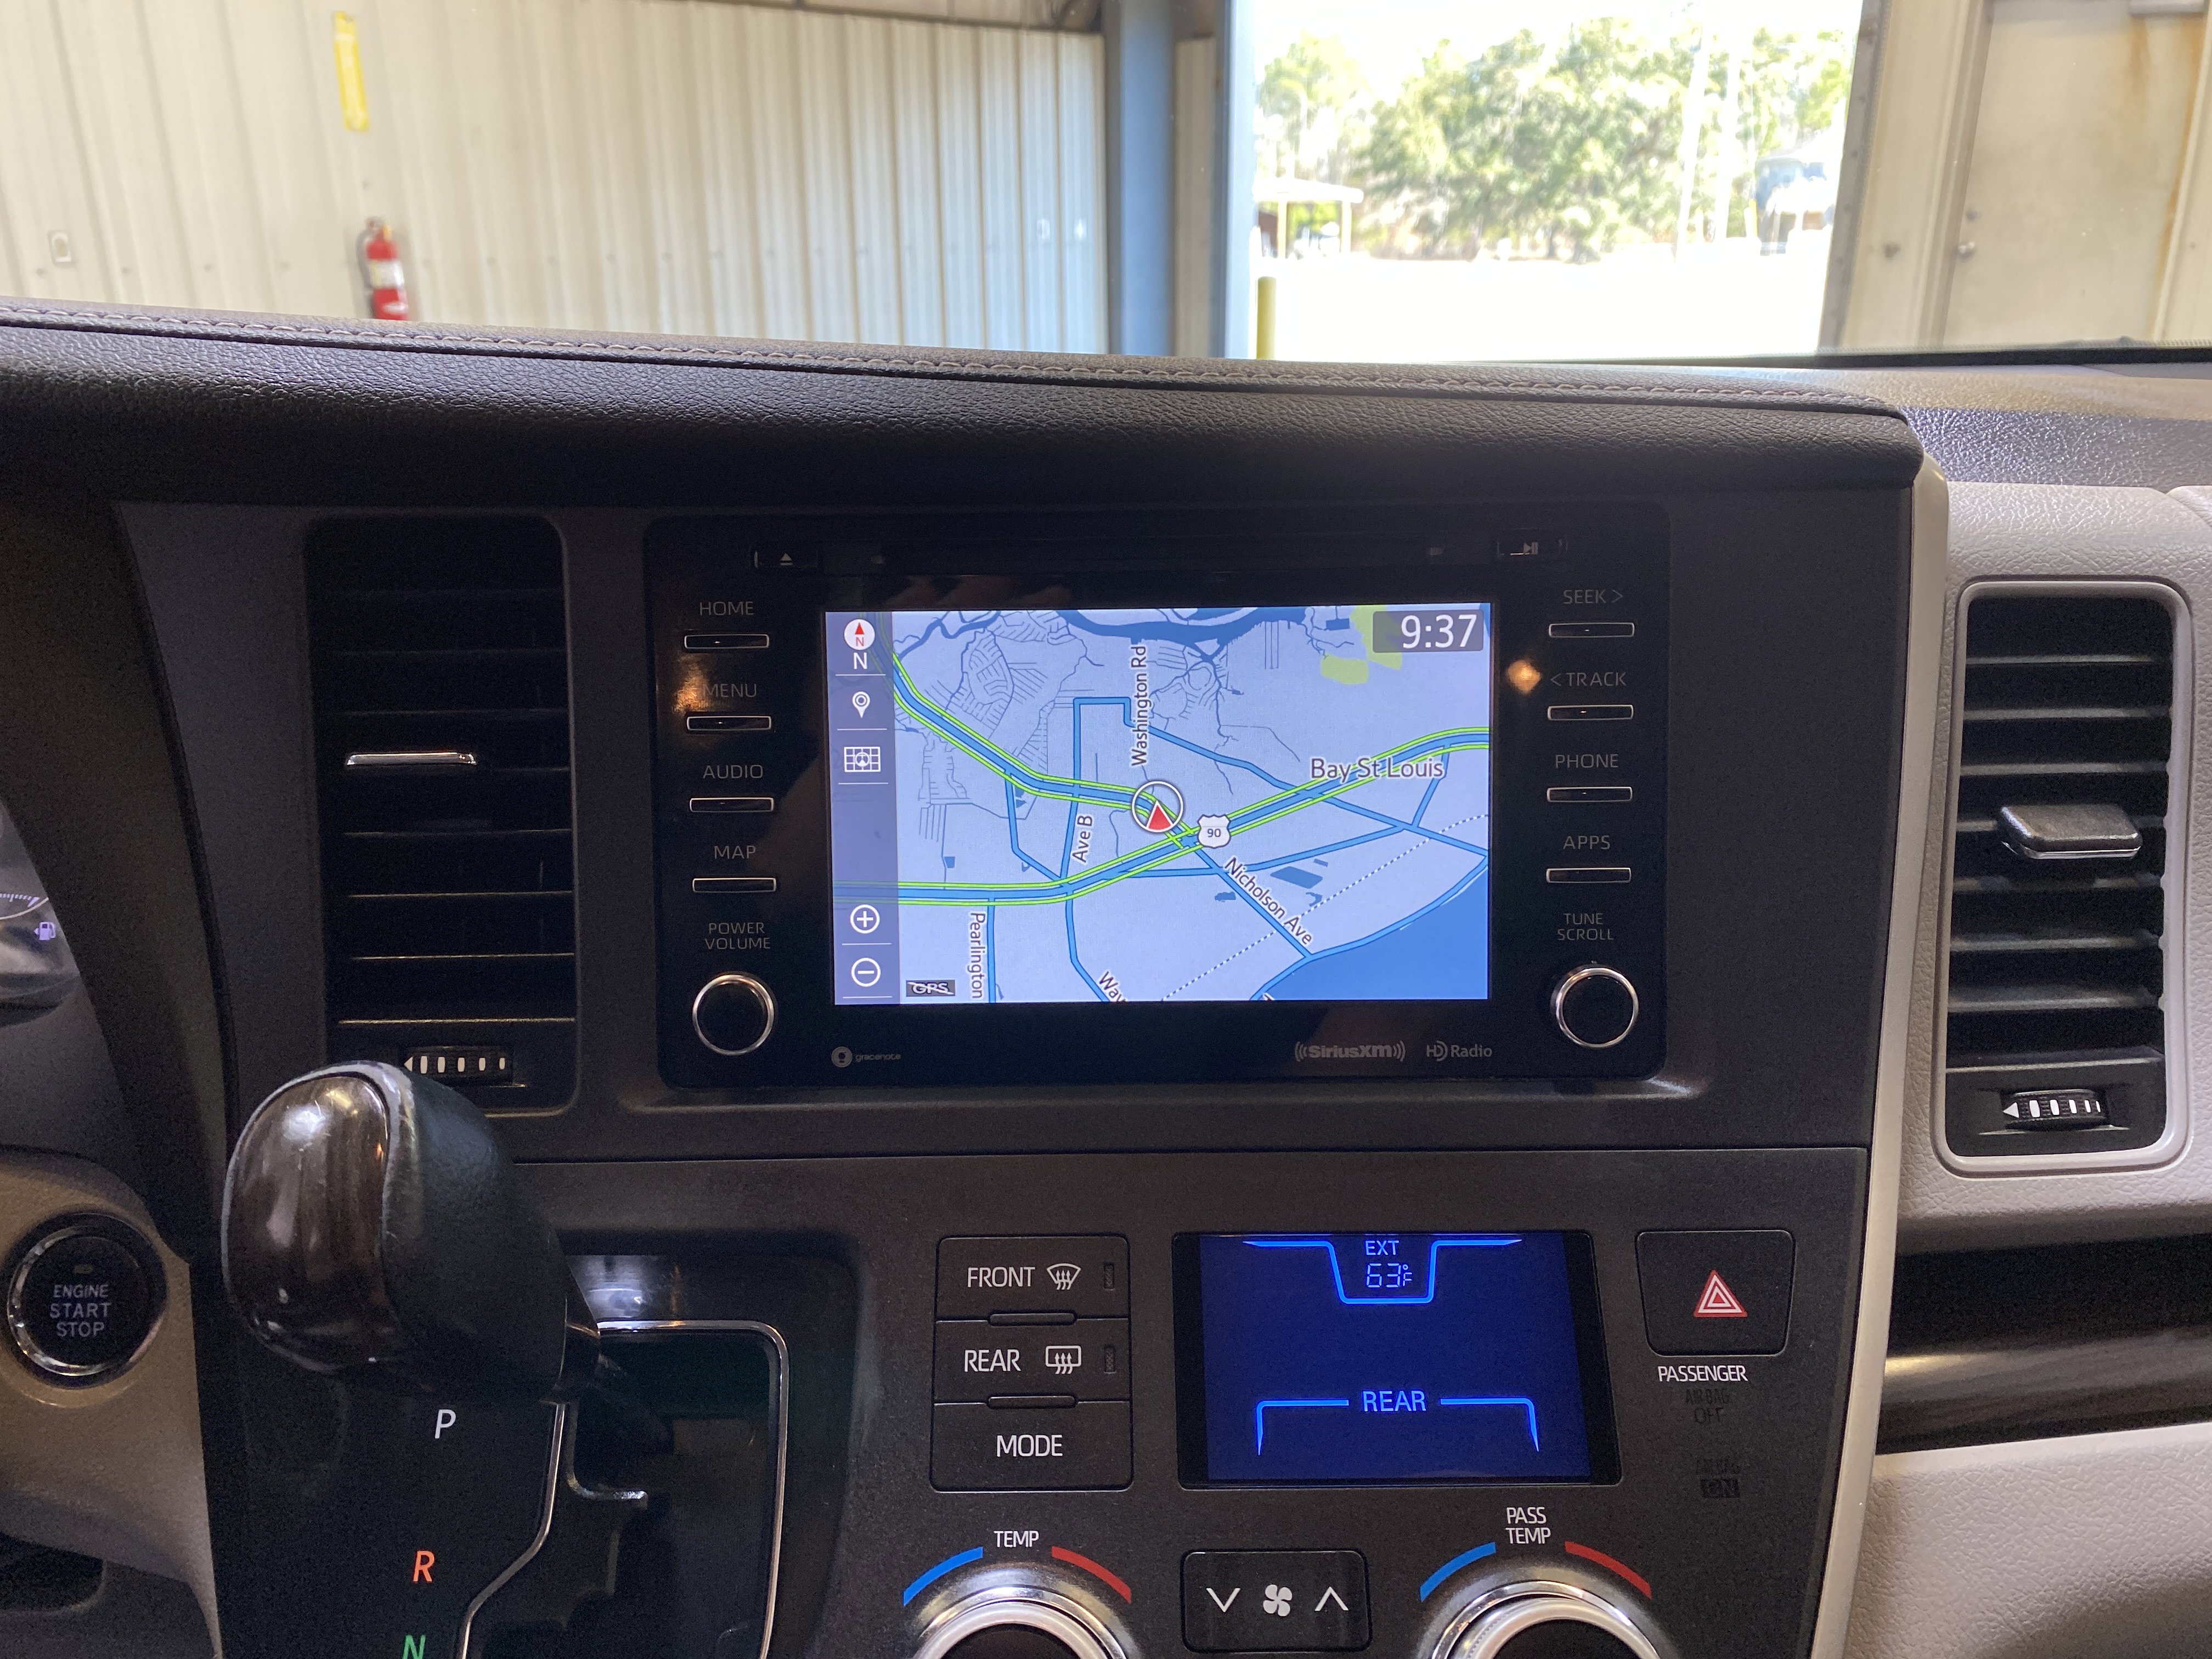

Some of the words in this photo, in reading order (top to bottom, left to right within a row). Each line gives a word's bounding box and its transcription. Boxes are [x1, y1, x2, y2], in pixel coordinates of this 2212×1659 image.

[1564, 589, 1606, 604] SEEK
[699, 601, 754, 616] HOME
[1401, 614, 1477, 649] 9:37
[856, 637, 865, 647] N
[854, 652, 867, 669] N
[1131, 646, 1147, 668] Rd
[1566, 672, 1627, 687] TRACK
[704, 684, 758, 698] MENU
[1131, 673, 1152, 766] Washington
[1555, 754, 1620, 768] PHONE
[703, 765, 764, 779] AUDIO
[1311, 758, 1351, 783] Bay
[1357, 758, 1380, 778] St
[1387, 758, 1443, 778] Louis
[1077, 815, 1093, 826] B
[1207, 828, 1221, 838] 90
[1071, 830, 1091, 863] Ave
[1563, 835, 1611, 850] APPS
[714, 845, 757, 859] MAP
[1224, 857, 1285, 919] Nicholson
[1284, 916, 1312, 945] Ave
[1564, 913, 1604, 926] TUNE
[708, 922, 765, 934] POWER
[1557, 928, 1613, 941] SCROLL
[705, 937, 771, 950] VOLUME
[967, 912, 986, 998] Pearlington
[912, 982, 949, 995] GPS
[1451, 1044, 1492, 1058] Radio
[1365, 1240, 1400, 1256] EXT
[967, 1266, 1036, 1288] FRONT
[54, 1284, 109, 1299] ENGINE
[49, 1302, 111, 1318] START
[56, 1321, 105, 1337] STOP
[964, 1349, 1021, 1372] REAR
[1657, 1365, 1748, 1382] PASSENGER
[1362, 1391, 1426, 1412] REAR
[435, 1409, 456, 1439] P
[996, 1434, 1063, 1457] MODE
[1506, 1506, 1547, 1524] PASS
[994, 1530, 1040, 1548] TEMP
[1505, 1527, 1551, 1544] TEMP
[413, 1550, 435, 1582] R
[402, 1634, 426, 1659] N
